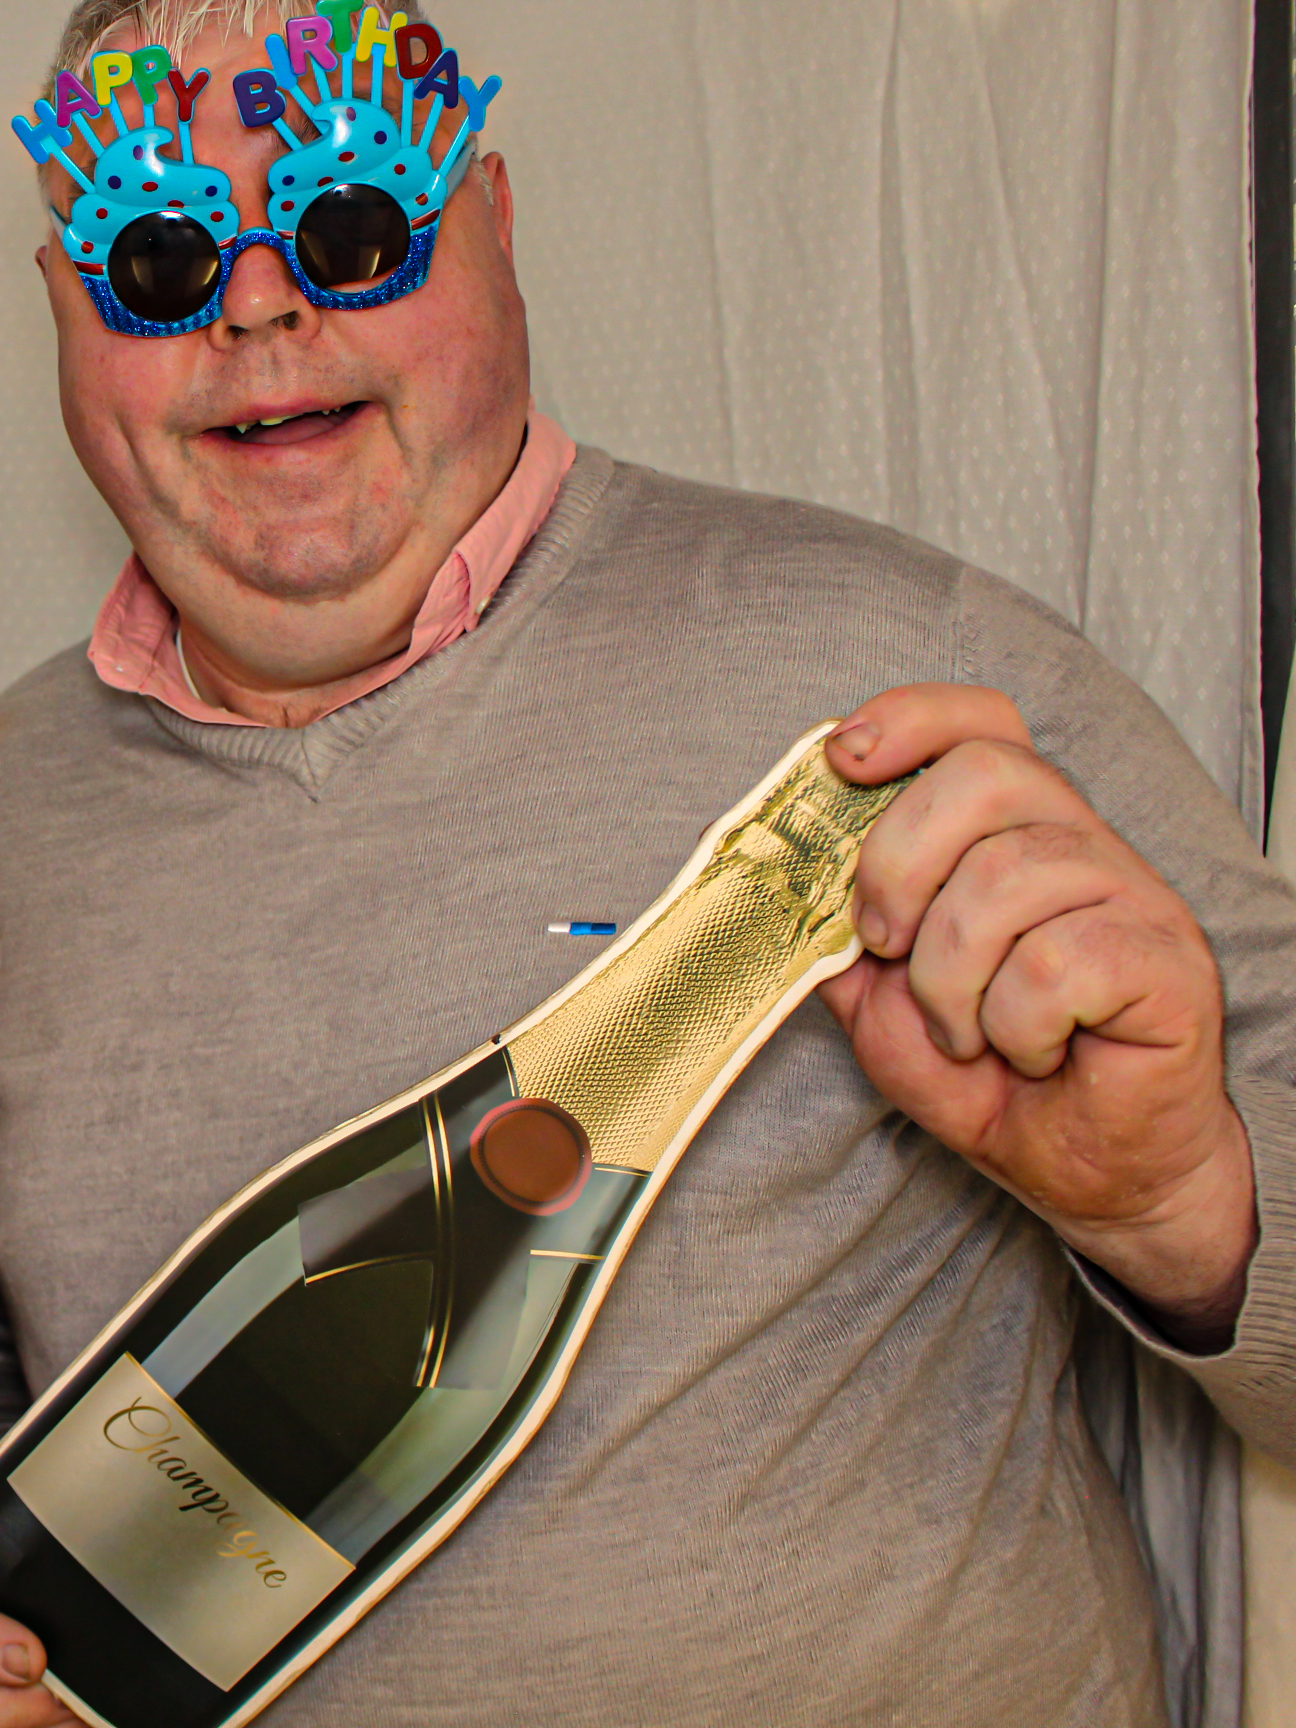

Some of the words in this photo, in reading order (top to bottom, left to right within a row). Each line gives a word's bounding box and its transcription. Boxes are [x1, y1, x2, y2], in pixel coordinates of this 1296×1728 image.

[11, 44, 211, 164] HAPPY
[233, 0, 502, 131] BIRTHDAY
[103, 1396, 287, 1588] Champagne
